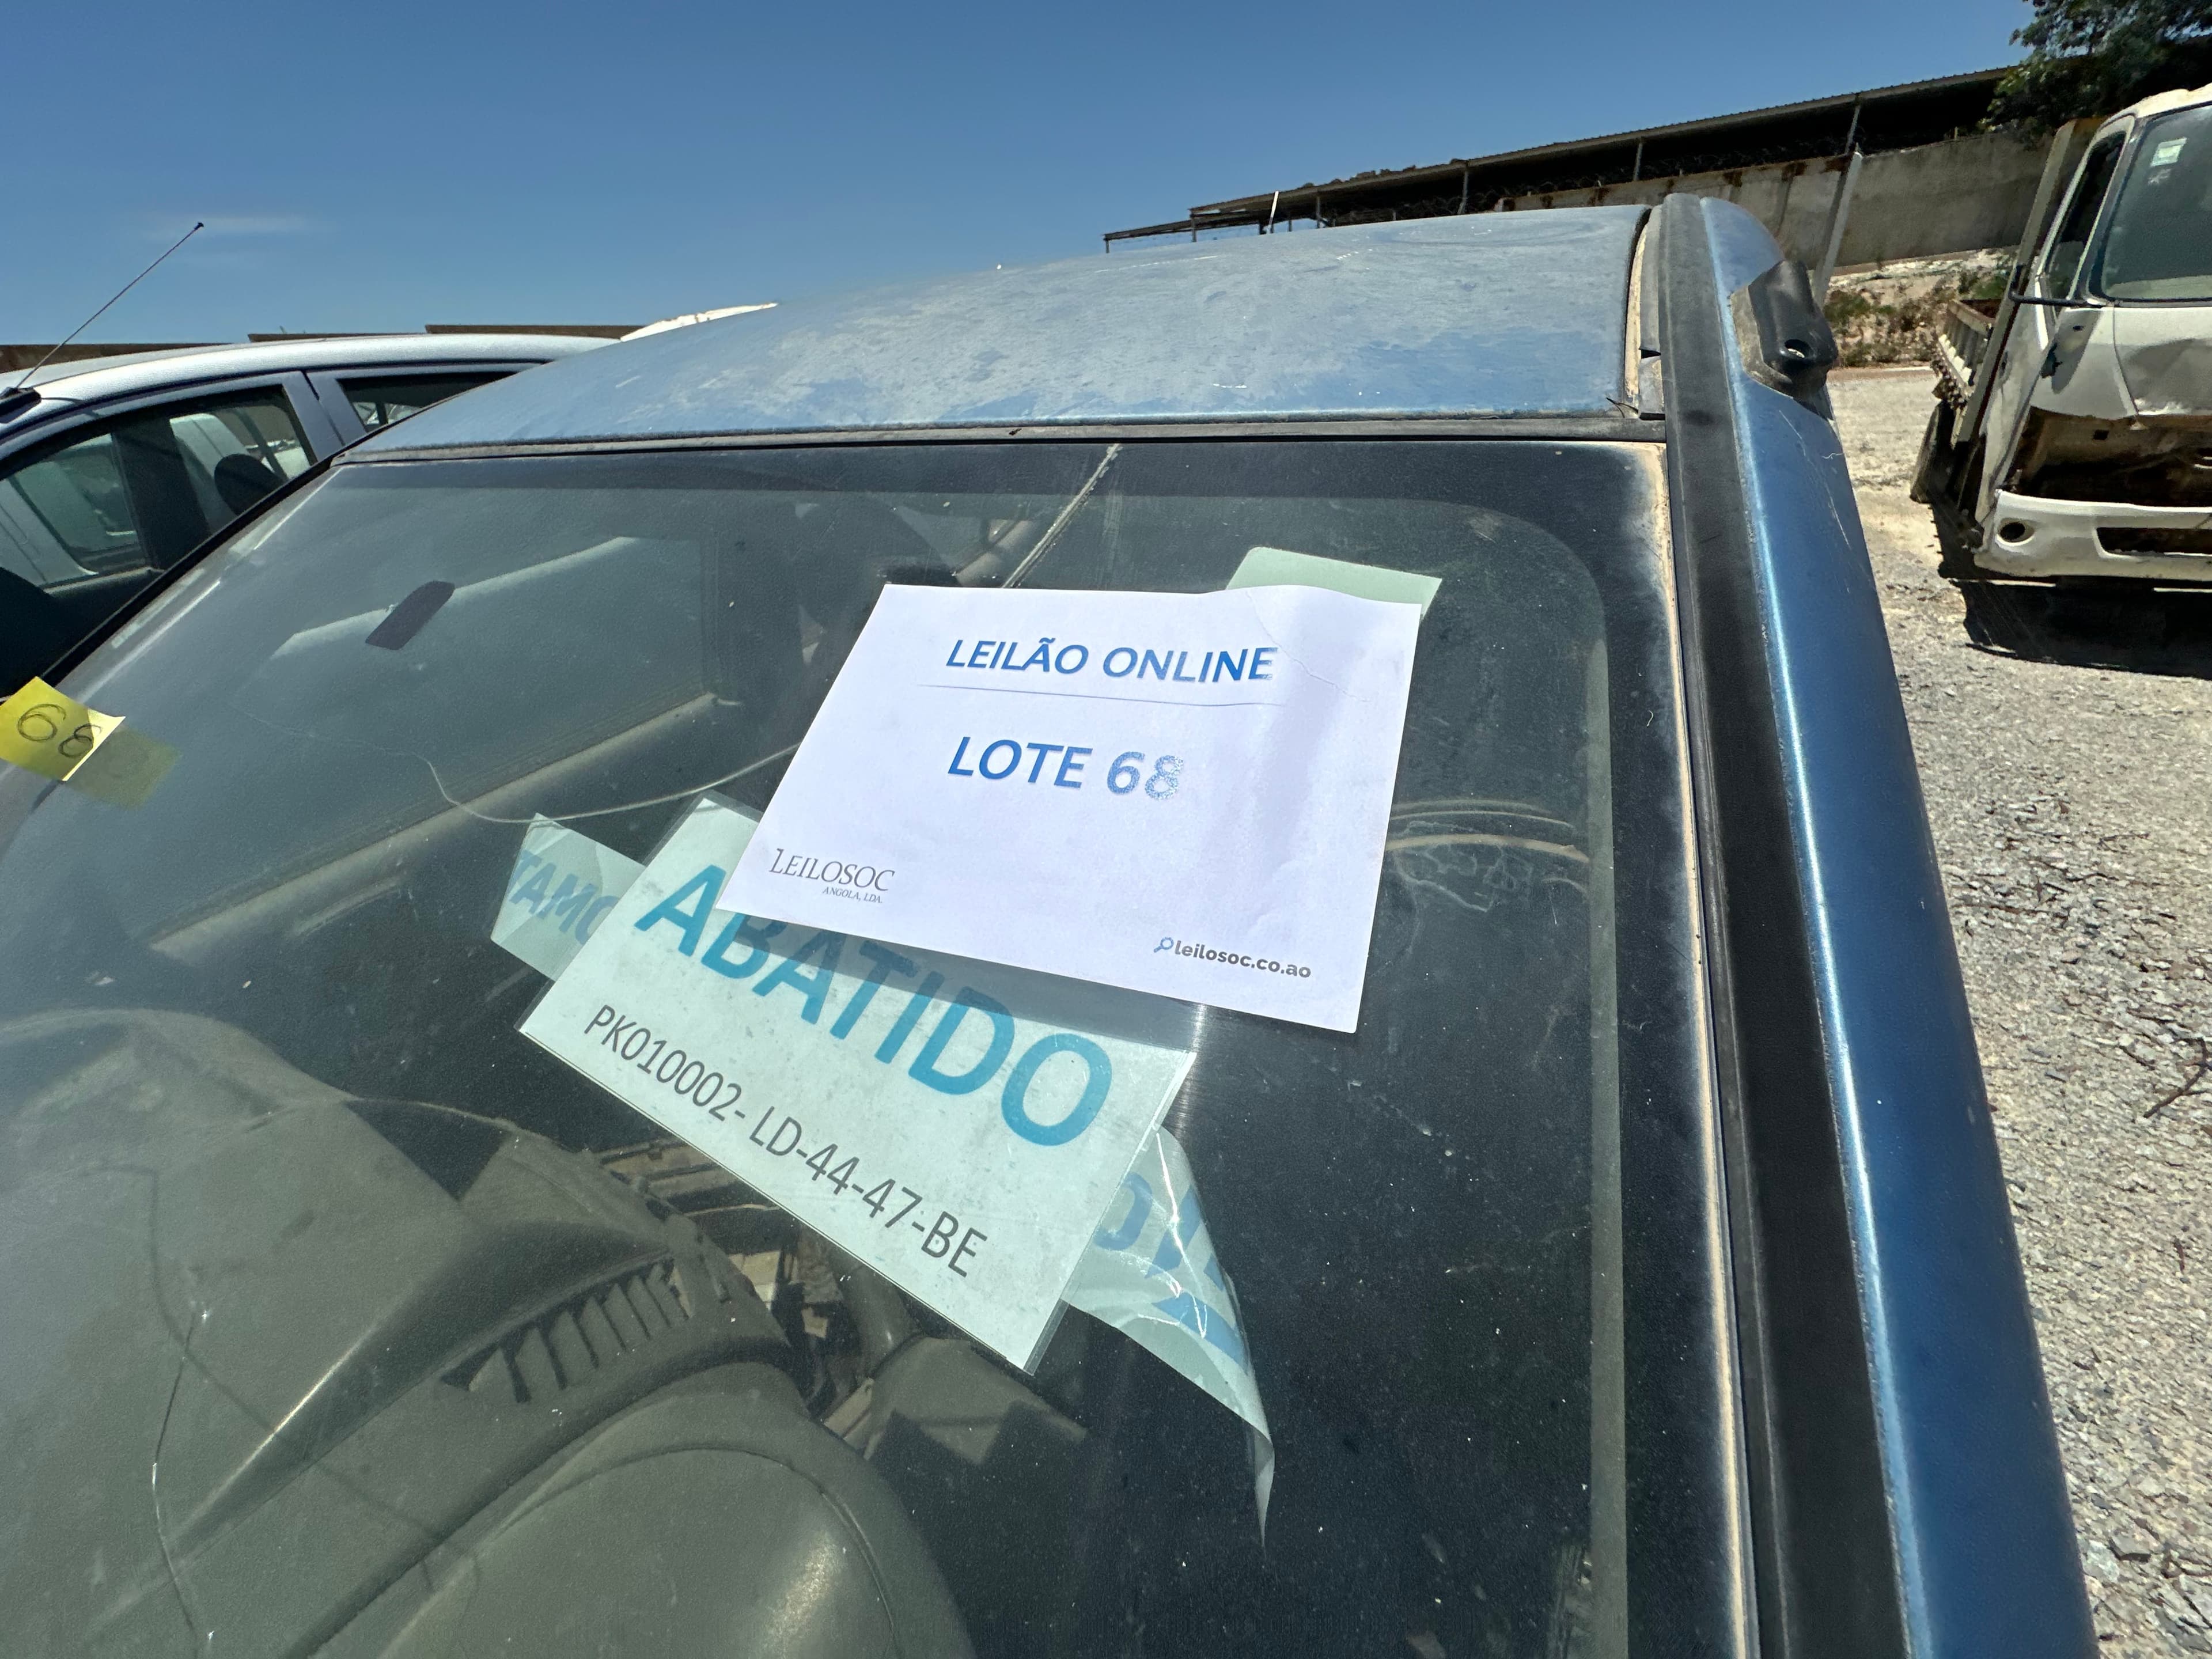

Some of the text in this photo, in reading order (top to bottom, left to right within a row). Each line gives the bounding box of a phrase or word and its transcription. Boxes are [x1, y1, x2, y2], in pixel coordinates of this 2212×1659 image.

[946, 638, 1278, 684] LEILÃO ONLINE
[17, 703, 102, 759] 68
[948, 736, 1185, 801] LOTE 68
[769, 847, 896, 892] LEILOSOC
[822, 886, 883, 904] ANGOLA, LDA.
[1174, 940, 1312, 978] leilosoc.co.ao
[634, 864, 1113, 1146] ABATIDO
[749, 1105, 987, 1278] LD-44-47-BE
